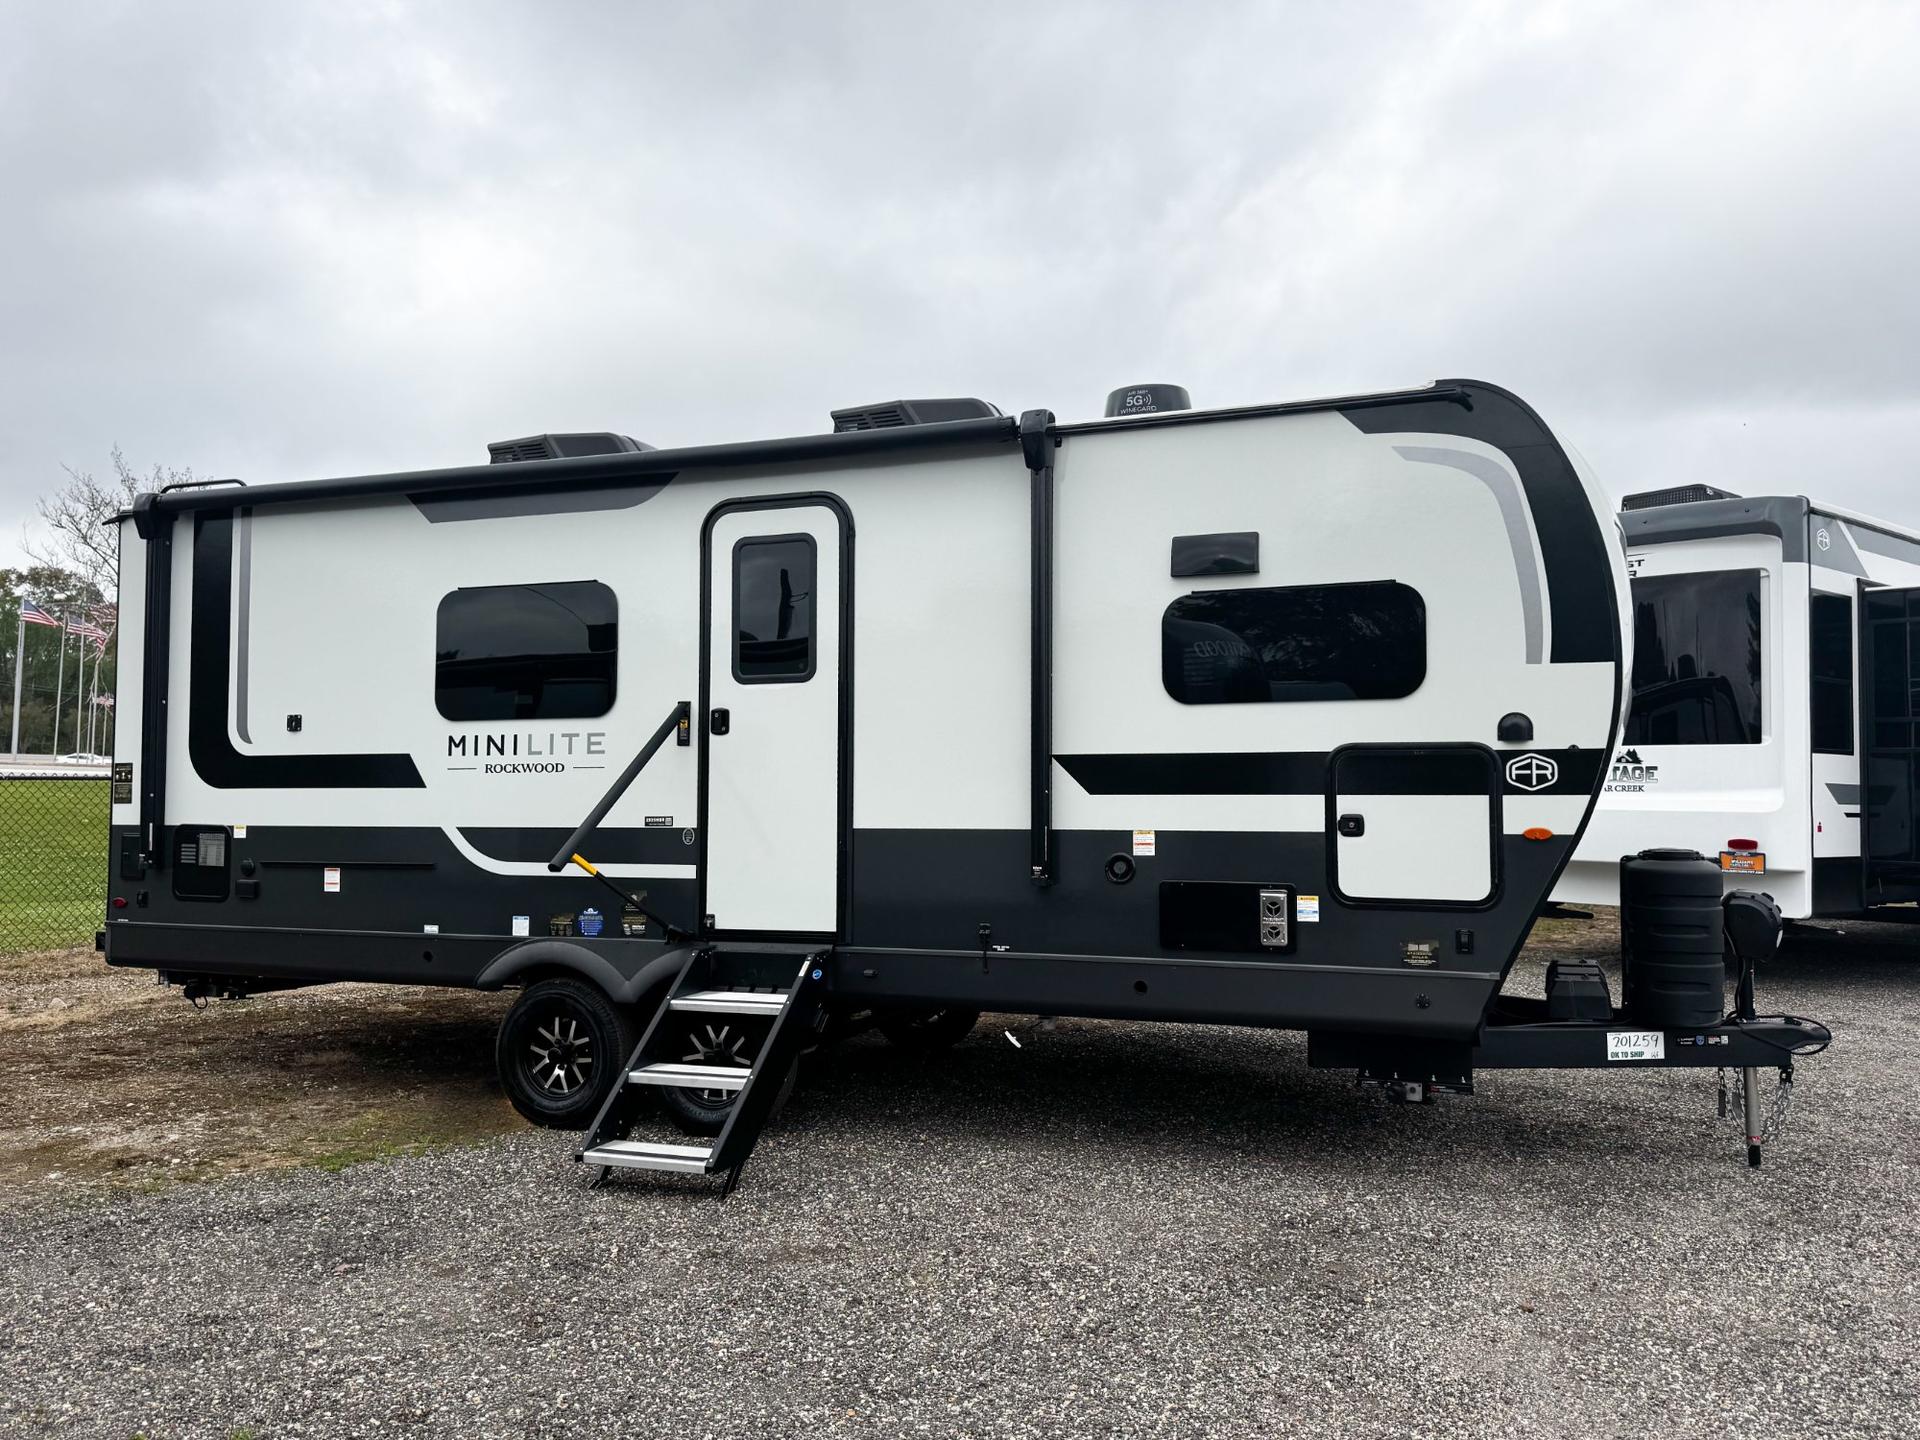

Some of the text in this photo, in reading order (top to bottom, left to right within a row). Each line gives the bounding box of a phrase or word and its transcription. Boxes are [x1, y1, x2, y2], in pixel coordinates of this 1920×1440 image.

[1126, 395, 1143, 406] 5G
[1120, 405, 1157, 414] WINEGARD
[485, 763, 565, 774] ROCKWOOD
